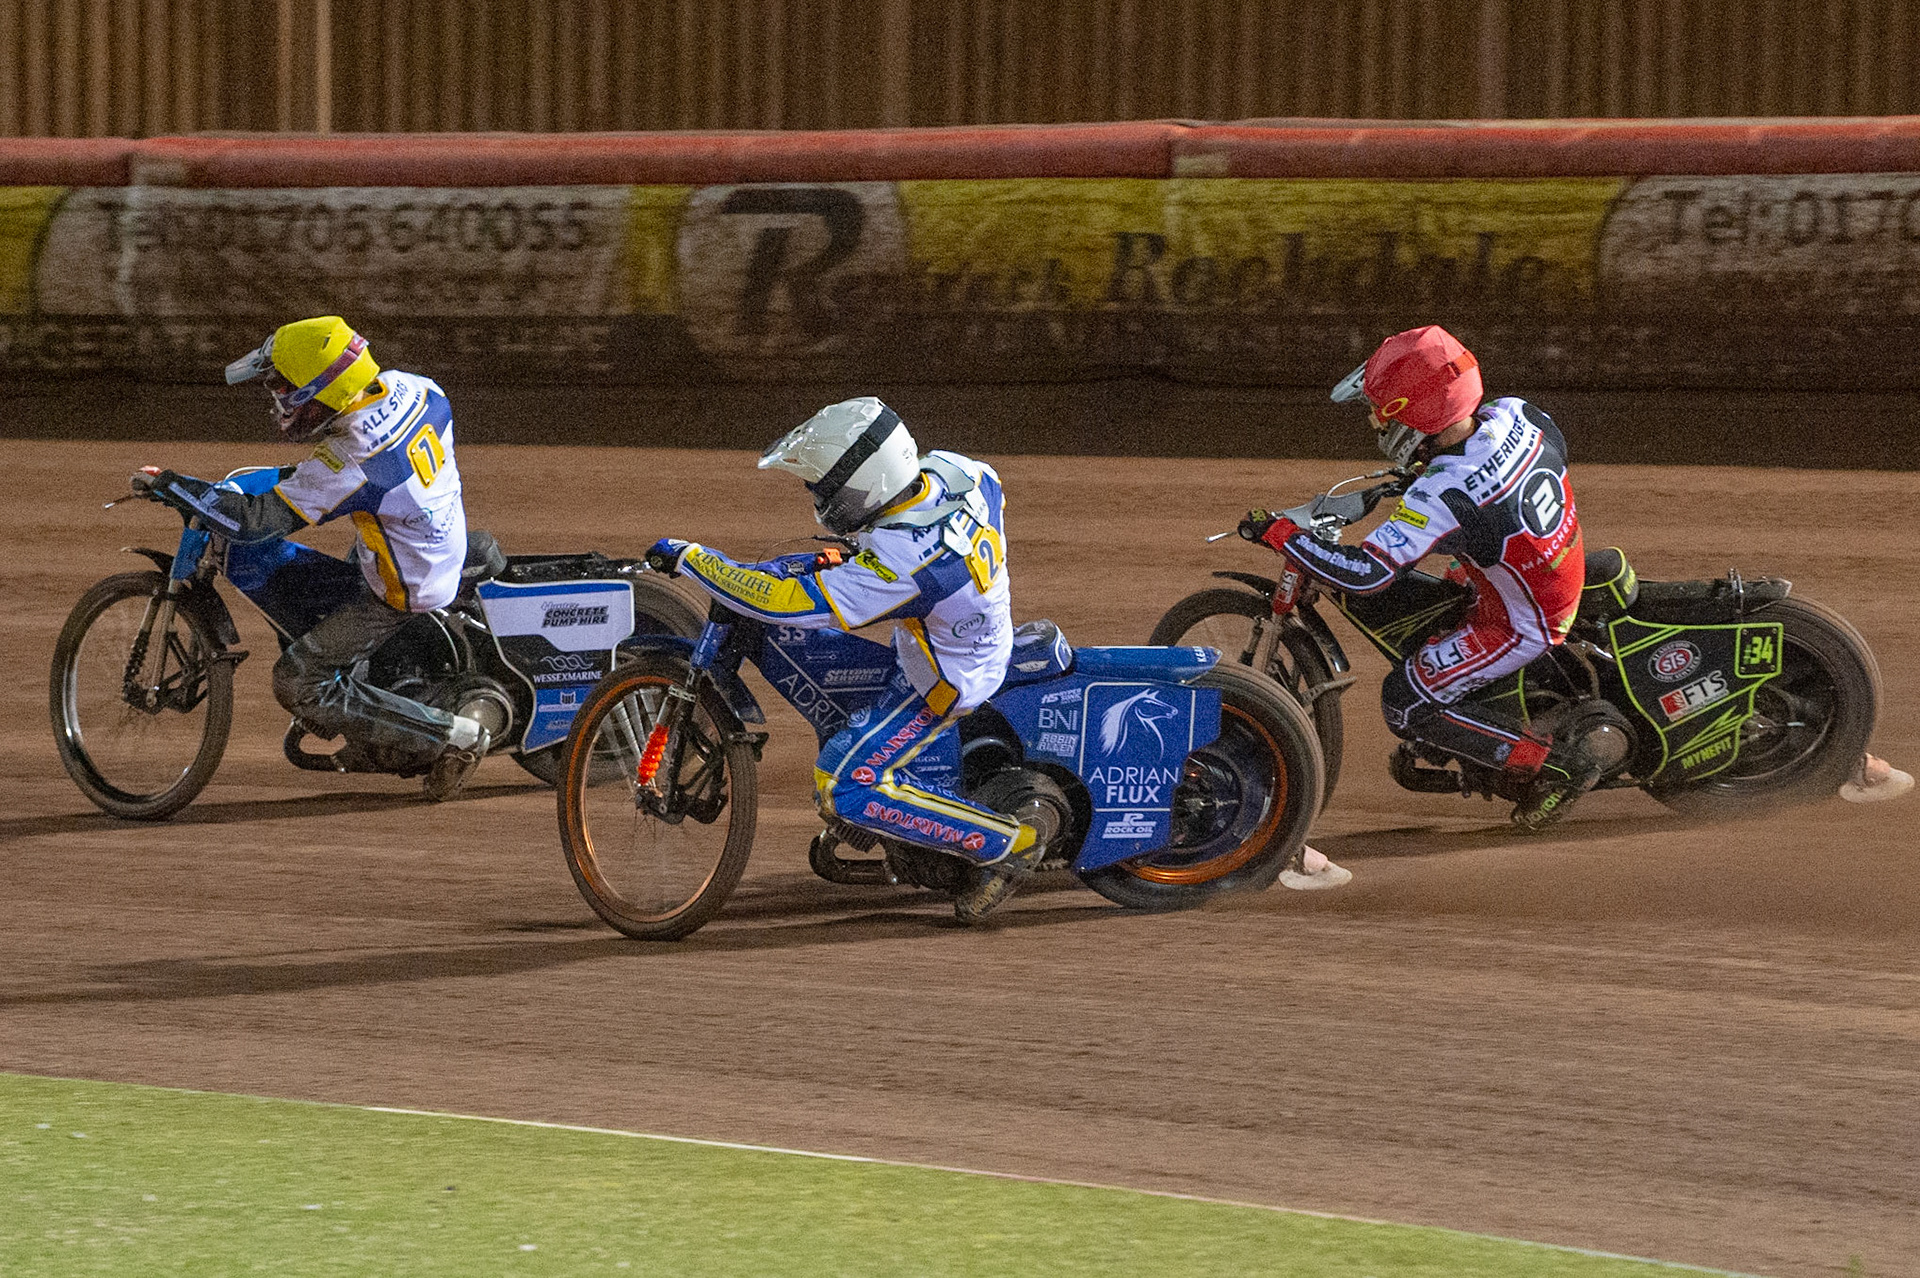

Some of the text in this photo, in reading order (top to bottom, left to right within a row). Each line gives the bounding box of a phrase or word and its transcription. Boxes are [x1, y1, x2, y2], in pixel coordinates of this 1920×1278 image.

[362, 408, 389, 434] ALL
[418, 437, 436, 474] 1
[1464, 415, 1526, 492] ETHERIDGE
[1531, 478, 1560, 530] 2
[978, 539, 999, 581] 2
[541, 615, 609, 629] PUMP HIRE
[545, 605, 609, 618] CONCRETE
[1661, 651, 1687, 673] STS
[532, 670, 603, 683] WESSEXMARINE
[1681, 671, 1727, 706] FTS
[1038, 708, 1078, 731] BNI
[865, 707, 934, 767] MARSTO
[1088, 766, 1180, 785] ADRIAN
[1105, 785, 1162, 804] FLUX
[863, 801, 965, 843] MARSTONS
[1104, 826, 1154, 834] ROCK OIL
